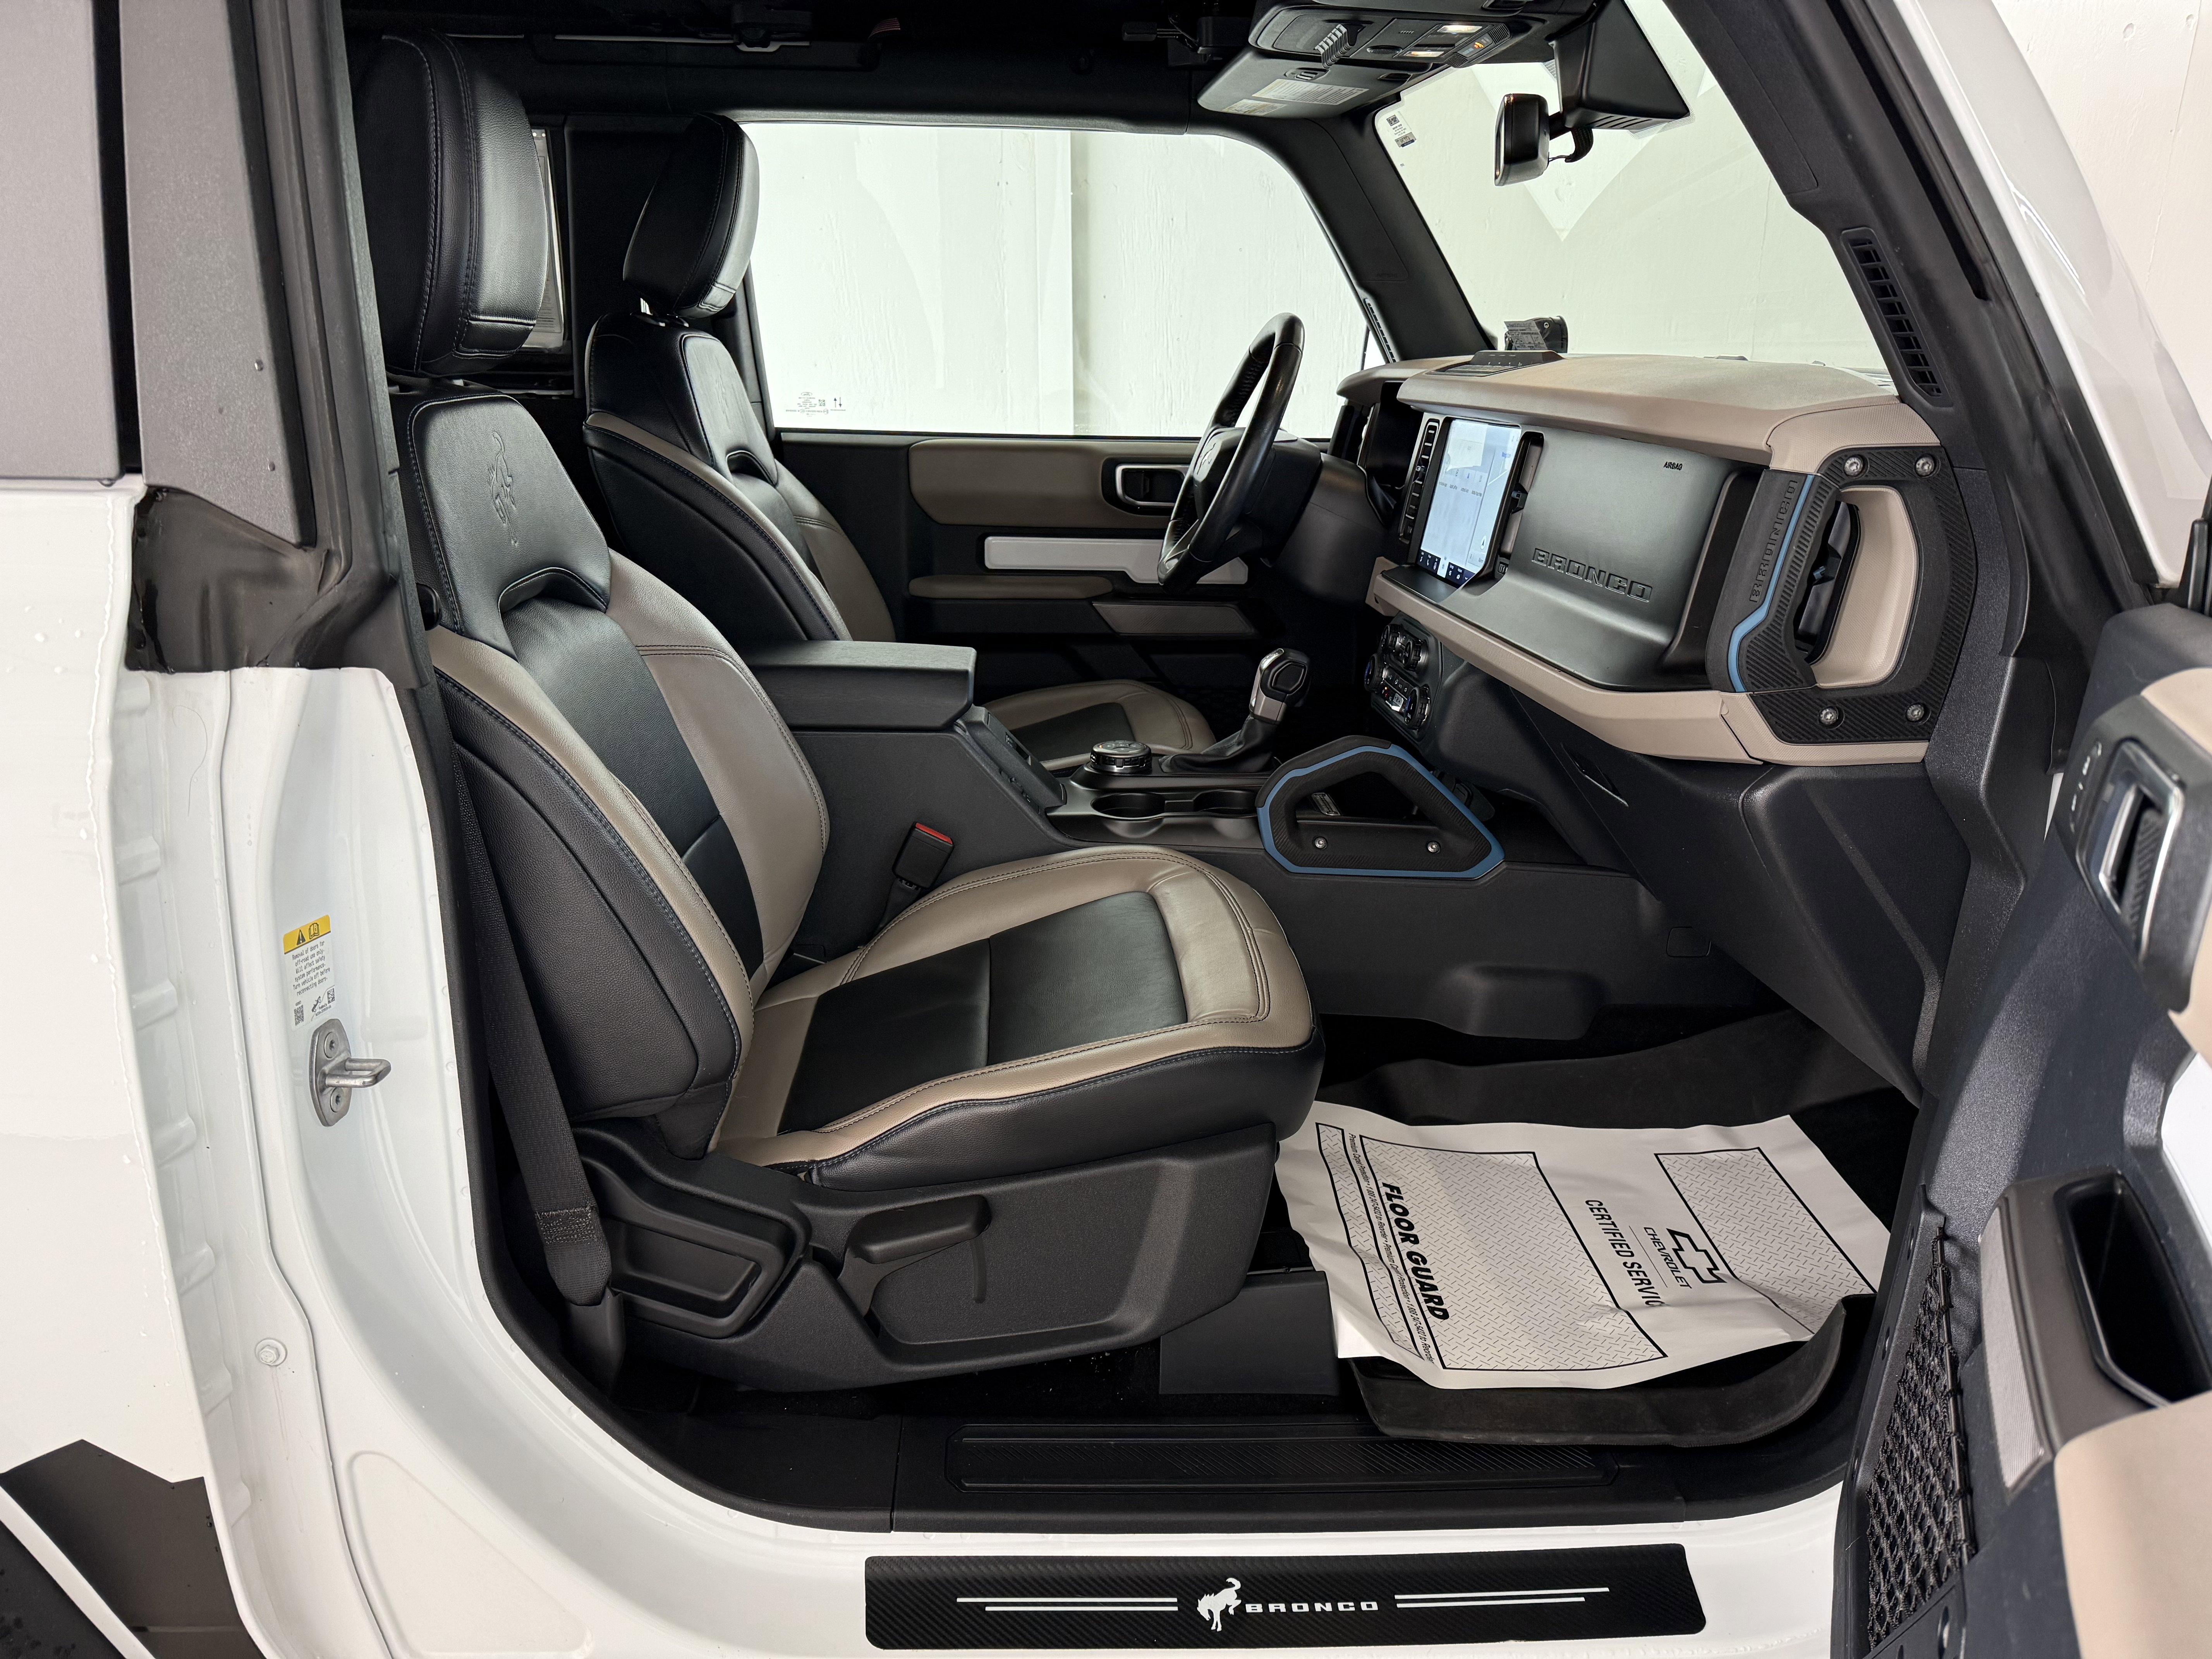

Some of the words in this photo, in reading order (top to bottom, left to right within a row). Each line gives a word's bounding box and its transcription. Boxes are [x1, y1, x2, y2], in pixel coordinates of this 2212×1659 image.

[1663, 461, 1683, 471] AIRBAG
[1749, 480, 1798, 603] BRONCO
[1532, 548, 1653, 603] BRONCO
[292, 950, 304, 960] Removal
[295, 955, 309, 967] off-road
[315, 955, 325, 964] safety
[295, 973, 305, 982] system
[302, 976, 313, 986] vehicle
[320, 967, 330, 976] before
[297, 982, 317, 996] reconnecting
[1348, 1133, 1358, 1153] Premium
[1357, 1164, 1370, 1183] Protection
[1377, 1220, 1388, 1240] Reorder
[1382, 1182, 1420, 1245] FLOOR
[1406, 1251, 1449, 1320] GUARD
[1382, 1242, 1395, 1264] Premium
[1585, 1200, 1635, 1257] CERTIFIED
[1623, 1261, 1666, 1307] SERVIC
[1643, 1227, 1692, 1289] CHEVROLET
[1397, 1274, 1410, 1300] Protection
[1245, 1601, 1378, 1613] BRONCO
